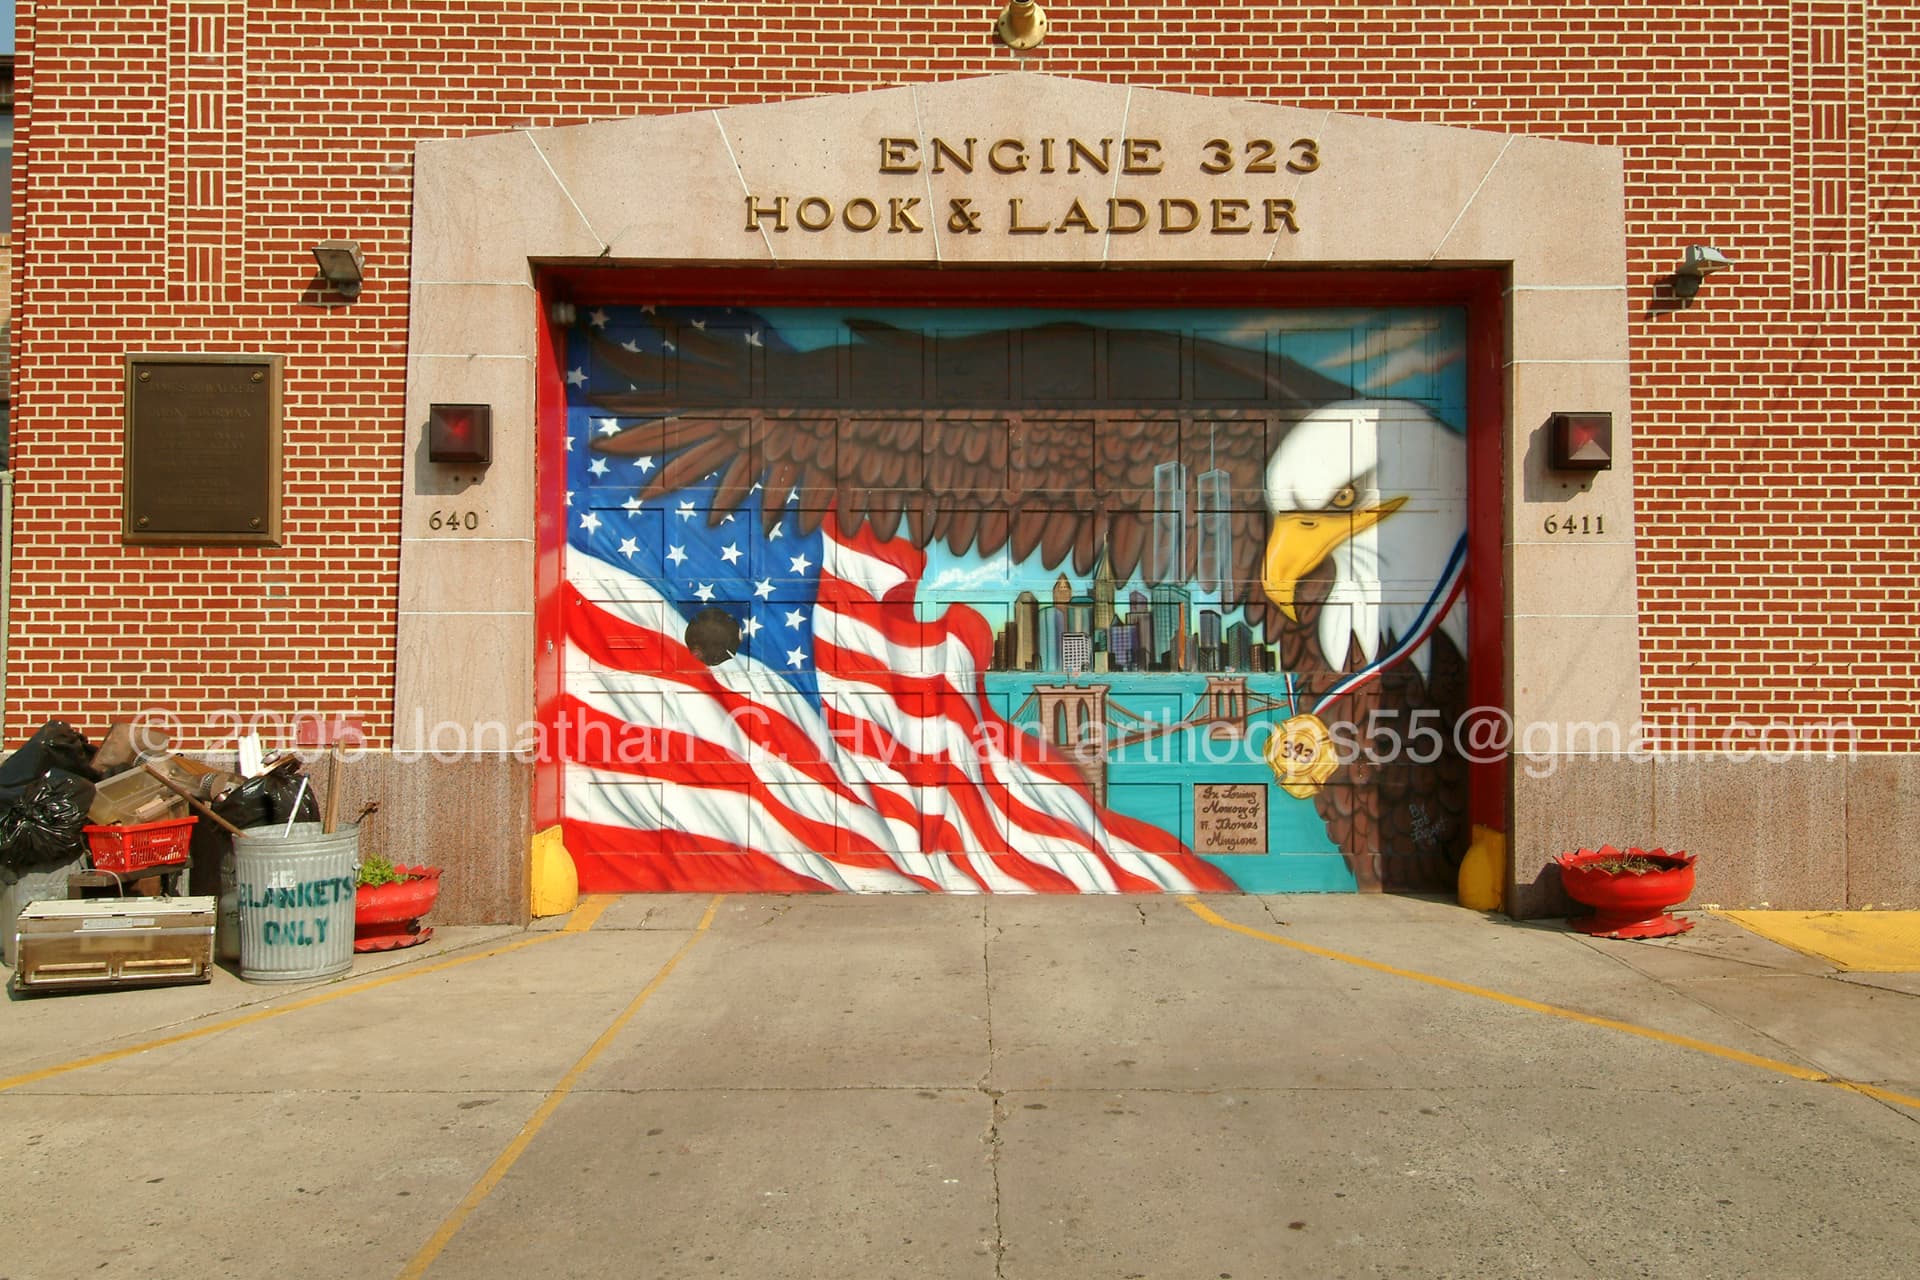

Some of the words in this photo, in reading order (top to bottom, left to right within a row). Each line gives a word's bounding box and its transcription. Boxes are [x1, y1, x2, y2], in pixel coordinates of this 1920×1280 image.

[879, 137, 1166, 175] ENGINE
[1200, 138, 1321, 175] 323
[745, 195, 924, 233] HOOK
[948, 197, 982, 234] &
[1008, 197, 1300, 234] LADDER
[429, 510, 479, 530] 640
[1544, 514, 1605, 534] 6411
[1281, 740, 1314, 764] 343
[1202, 800, 1248, 819] Memory
[1248, 803, 1261, 817] of
[1215, 818, 1258, 830] Thomas
[238, 876, 353, 908] BLANKETS
[263, 916, 329, 945] ONLY
